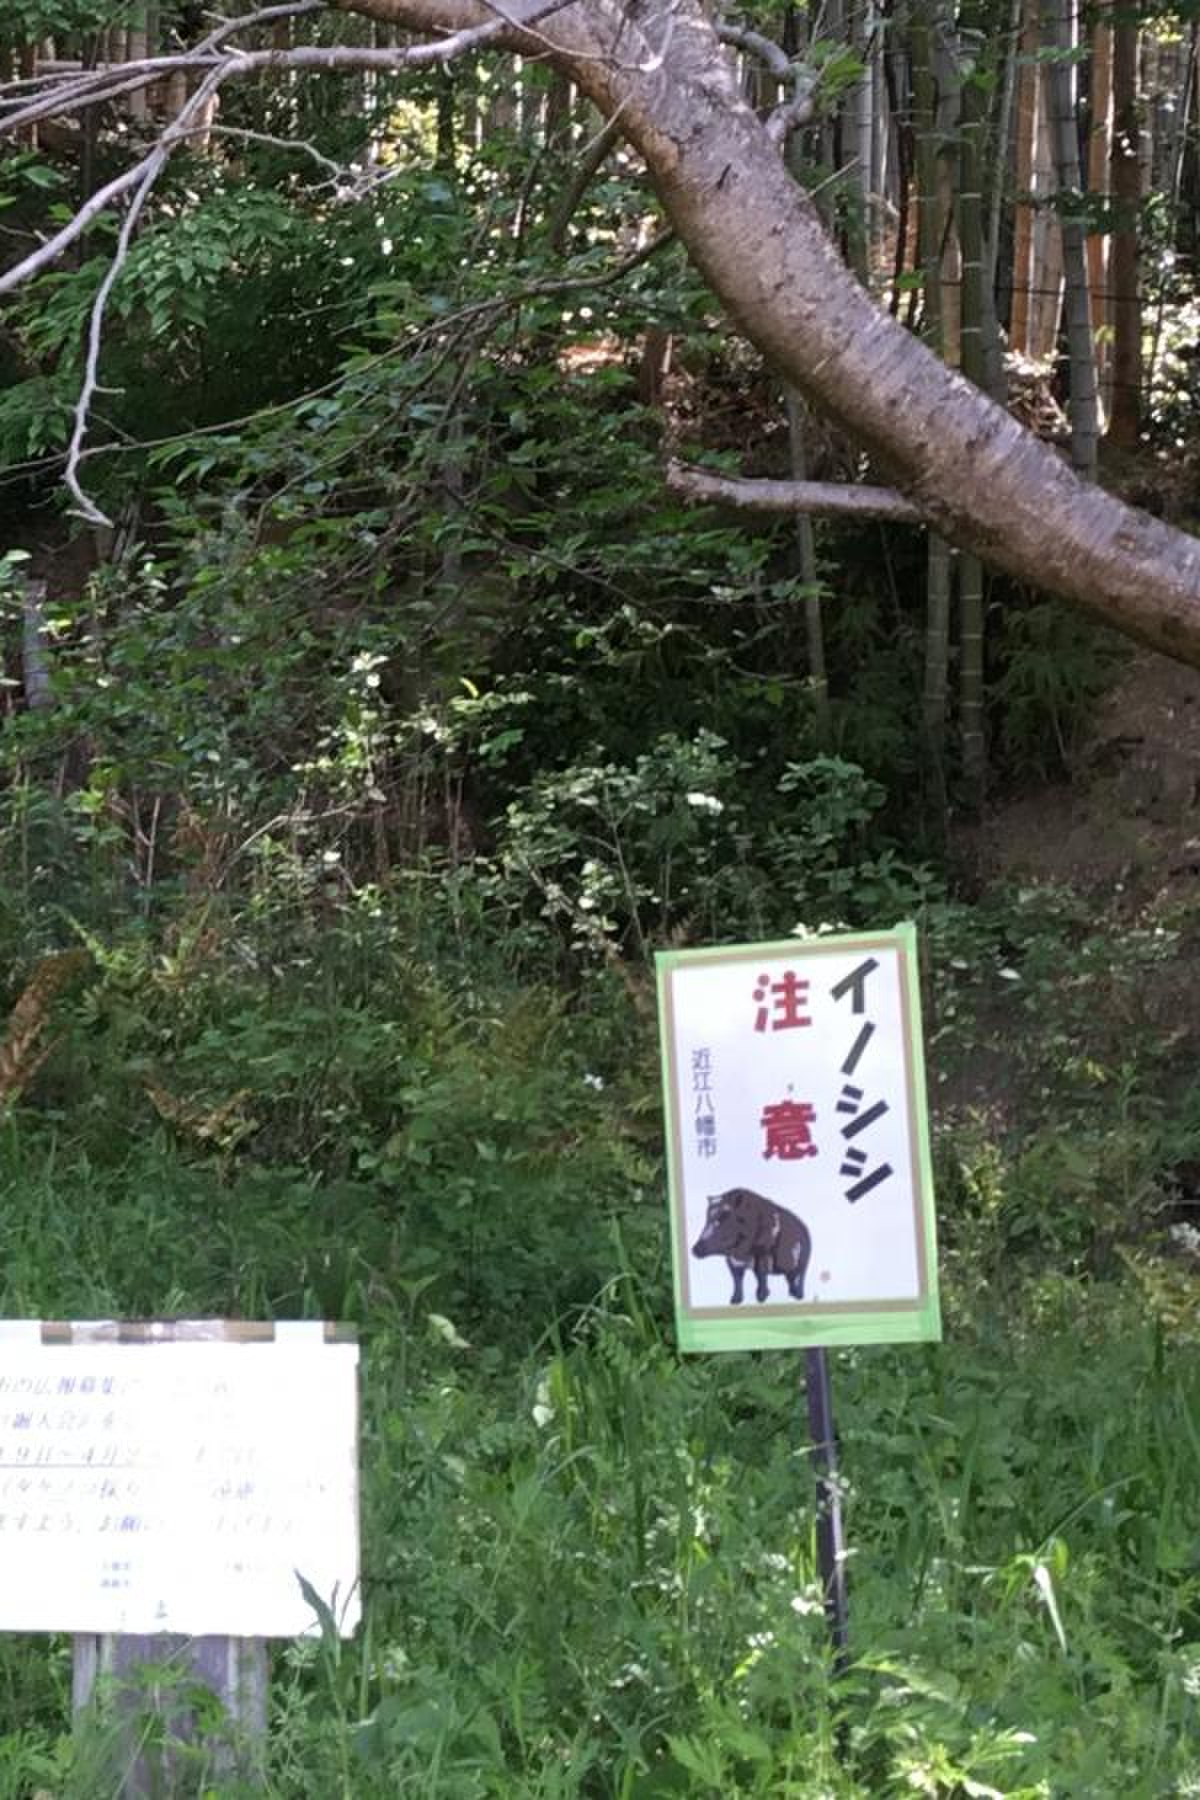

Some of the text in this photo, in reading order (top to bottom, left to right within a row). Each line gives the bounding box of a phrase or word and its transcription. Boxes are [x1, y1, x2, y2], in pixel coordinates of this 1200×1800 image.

[691, 1047, 717, 1159] 近江八幡市
[752, 970, 819, 1161] 注意
[830, 957, 894, 1204] イノシシ
